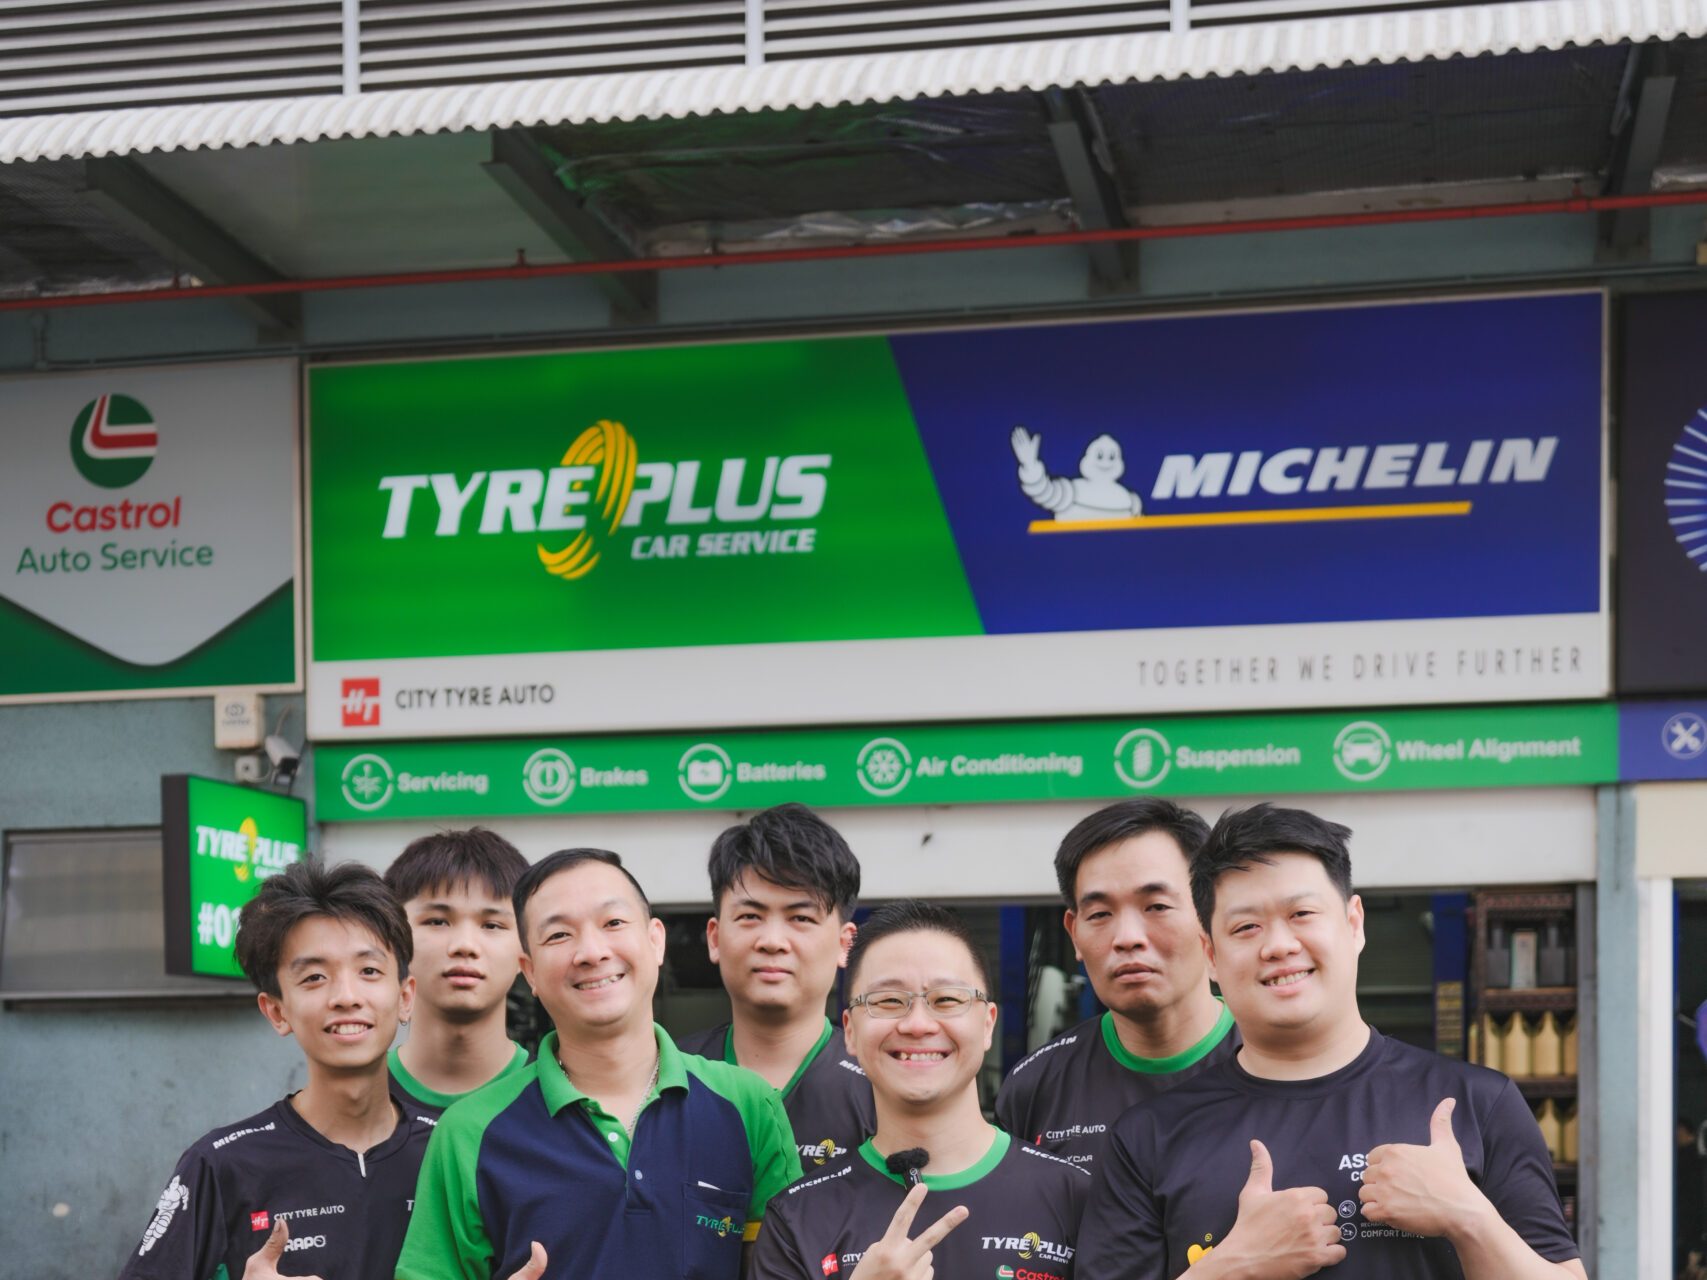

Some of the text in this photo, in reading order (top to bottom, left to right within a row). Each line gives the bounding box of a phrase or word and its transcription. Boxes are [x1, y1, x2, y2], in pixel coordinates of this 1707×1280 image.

[1151, 436, 1559, 499] MICHELIN
[378, 453, 832, 539] TYRE PLUS
[46, 496, 181, 534] Castrol
[16, 538, 214, 575] Auto Service
[630, 528, 817, 560] CAR SERVICE
[1138, 645, 1582, 687] TOGETHER WE DRIVE FURTHER
[395, 683, 556, 710] CITY TYRE AUTO
[1176, 742, 1301, 772] Suspension
[1396, 735, 1583, 763] Wheel Alignment
[579, 766, 649, 788] Brakes
[736, 761, 827, 783] Batteries
[916, 752, 1084, 778] Air Conditioning
[397, 770, 490, 796] Servicing
[195, 824, 249, 863] TYRE
[1046, 1129, 1065, 1140] CITY
[1081, 1123, 1106, 1134] AUTO
[273, 1204, 345, 1222] CITY TYRE AUTO
[981, 1236, 1032, 1251] TYRE
[1360, 1228, 1400, 1239] COMFORT
[842, 1252, 862, 1263] CITY
[1039, 1252, 1052, 1261] CAR
